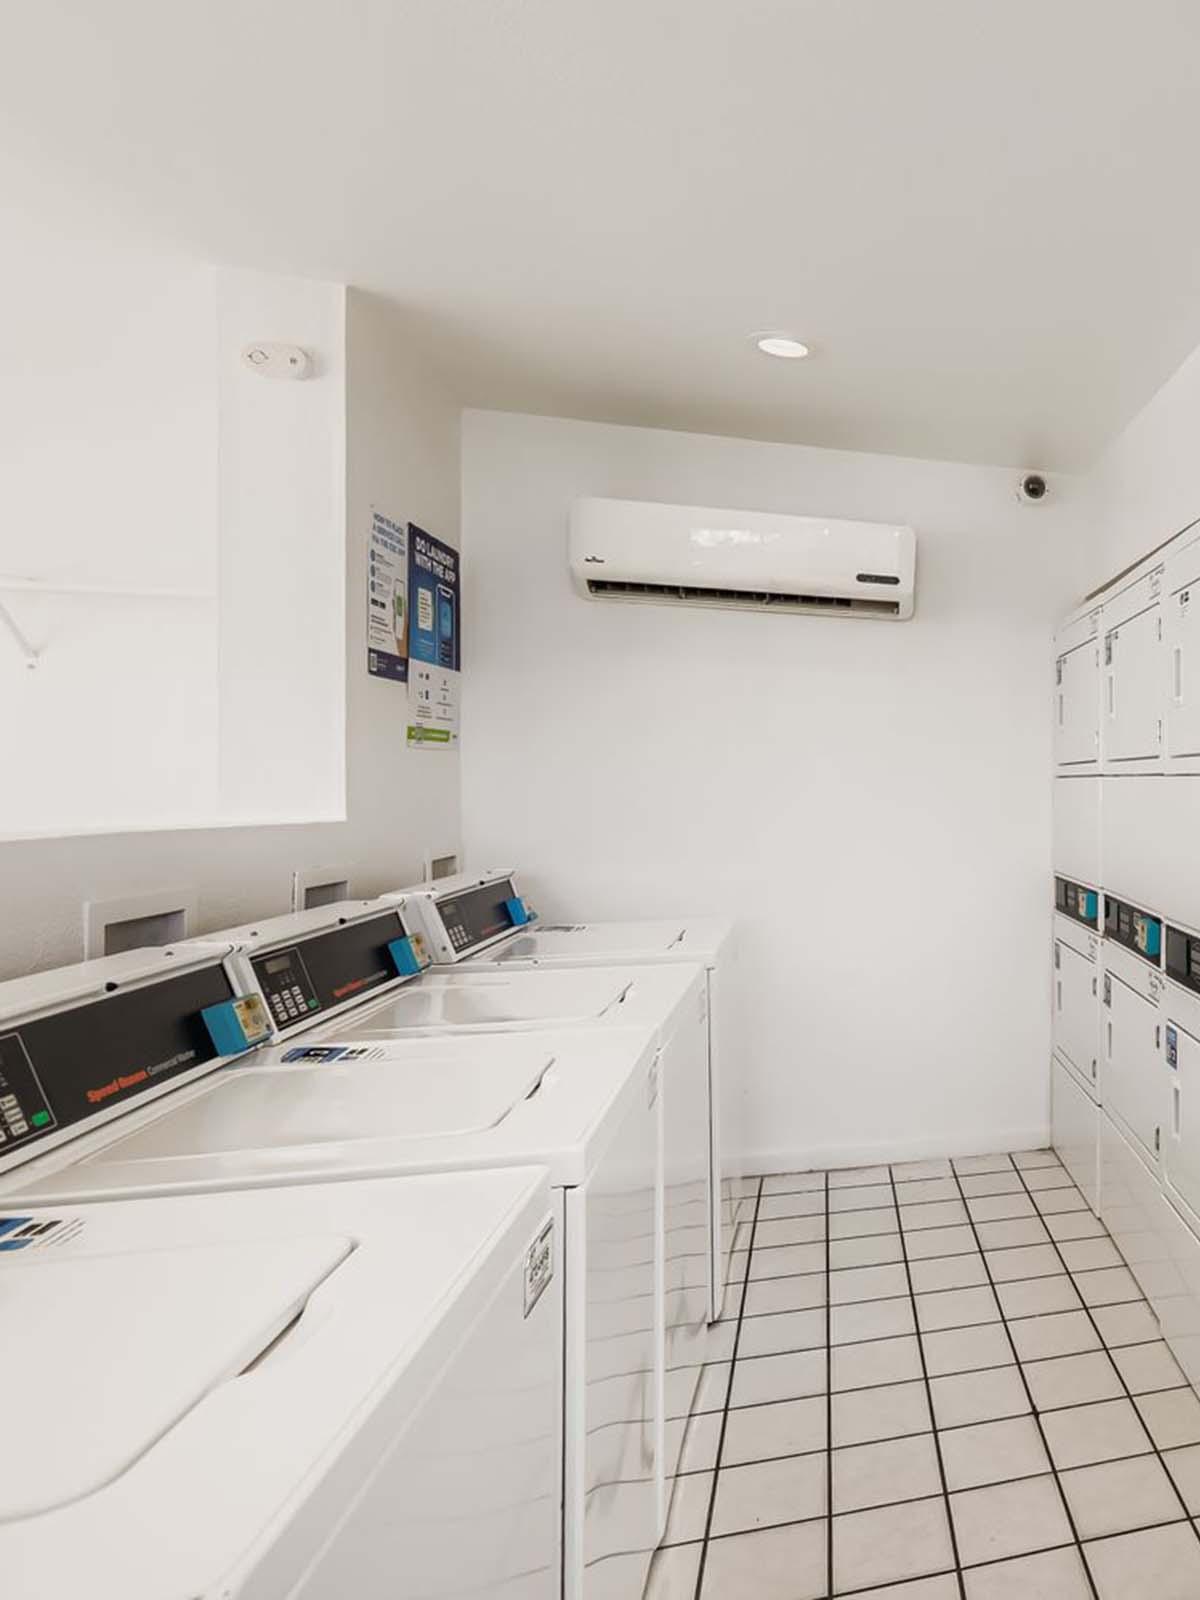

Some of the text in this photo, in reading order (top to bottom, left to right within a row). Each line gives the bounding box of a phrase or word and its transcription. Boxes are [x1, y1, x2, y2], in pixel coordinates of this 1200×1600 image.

[415, 536, 455, 570] DO LAUNDRY
[415, 552, 457, 584] WITH THE APP
[87, 1079, 120, 1103] Speed
